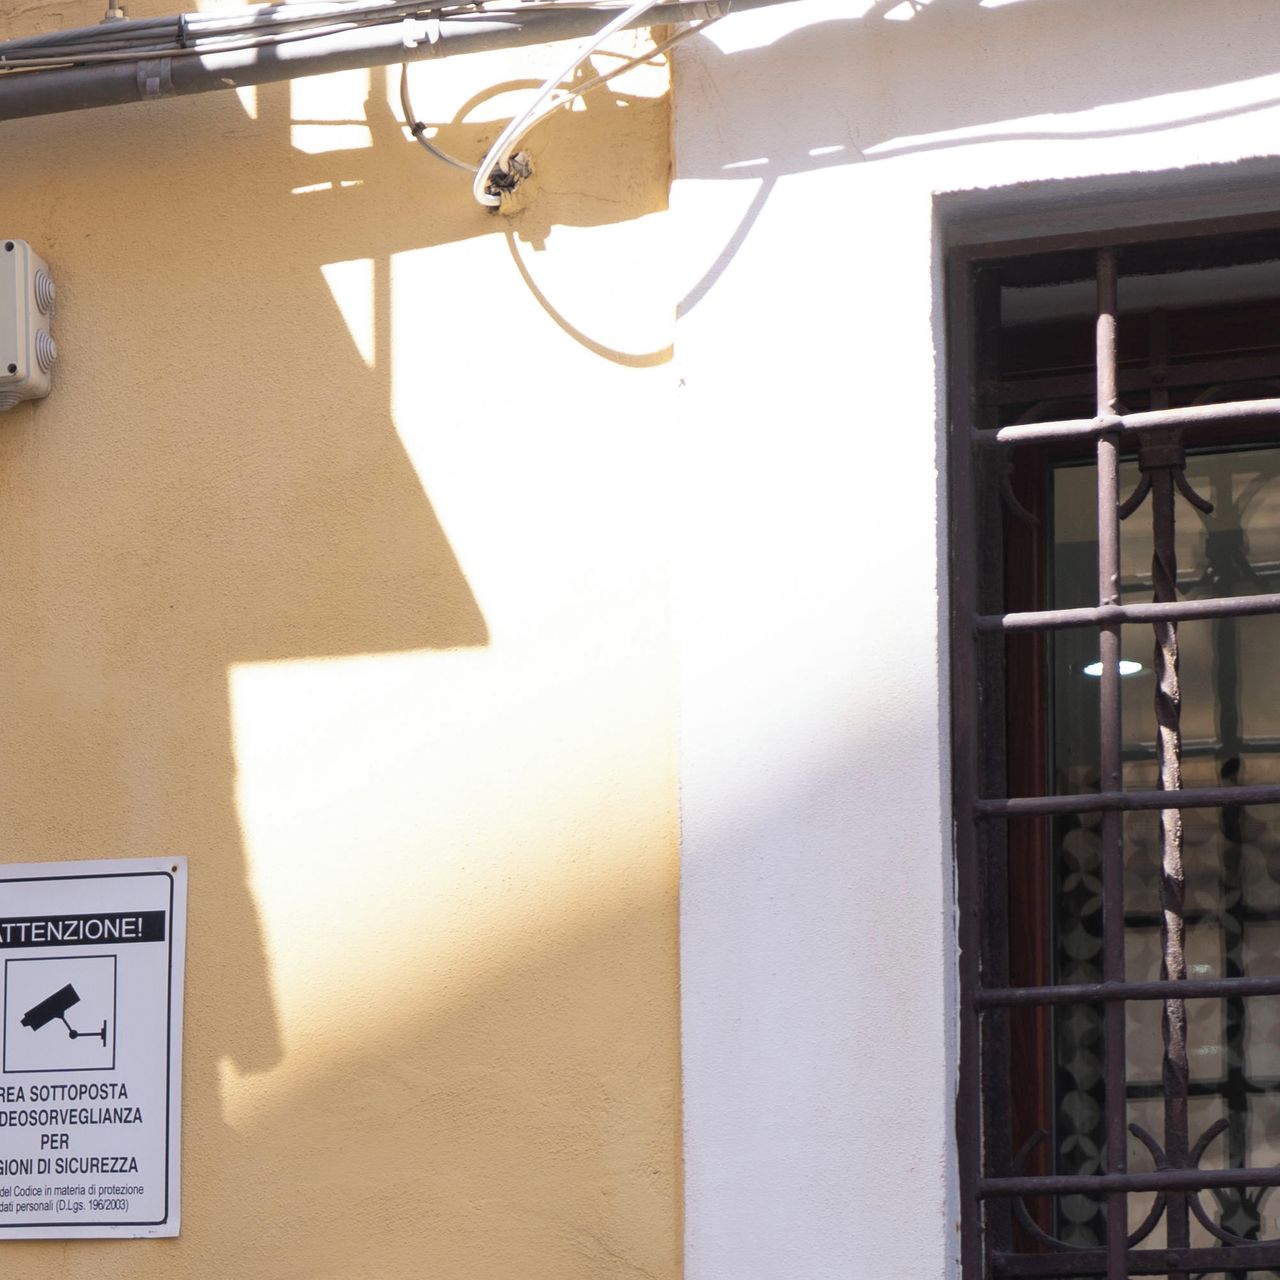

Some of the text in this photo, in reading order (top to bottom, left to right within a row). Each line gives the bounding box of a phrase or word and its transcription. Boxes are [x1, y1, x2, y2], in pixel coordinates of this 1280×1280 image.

[29, 1082, 129, 1103] SOTTOPOSTA
[40, 1133, 70, 1151] PER
[36, 1157, 52, 1175] DI
[54, 1155, 139, 1175] SICUREZZA
[0, 1186, 12, 1198] del
[13, 1185, 43, 1197] Codice
[44, 1185, 53, 1196] in
[53, 1184, 86, 1196] materia
[87, 1184, 97, 1195] di
[97, 1184, 145, 1198] protezione
[15, 1200, 54, 1215] personali
[55, 1199, 85, 1214] (D.Lgs.
[88, 1198, 130, 1213] 196/2003)
